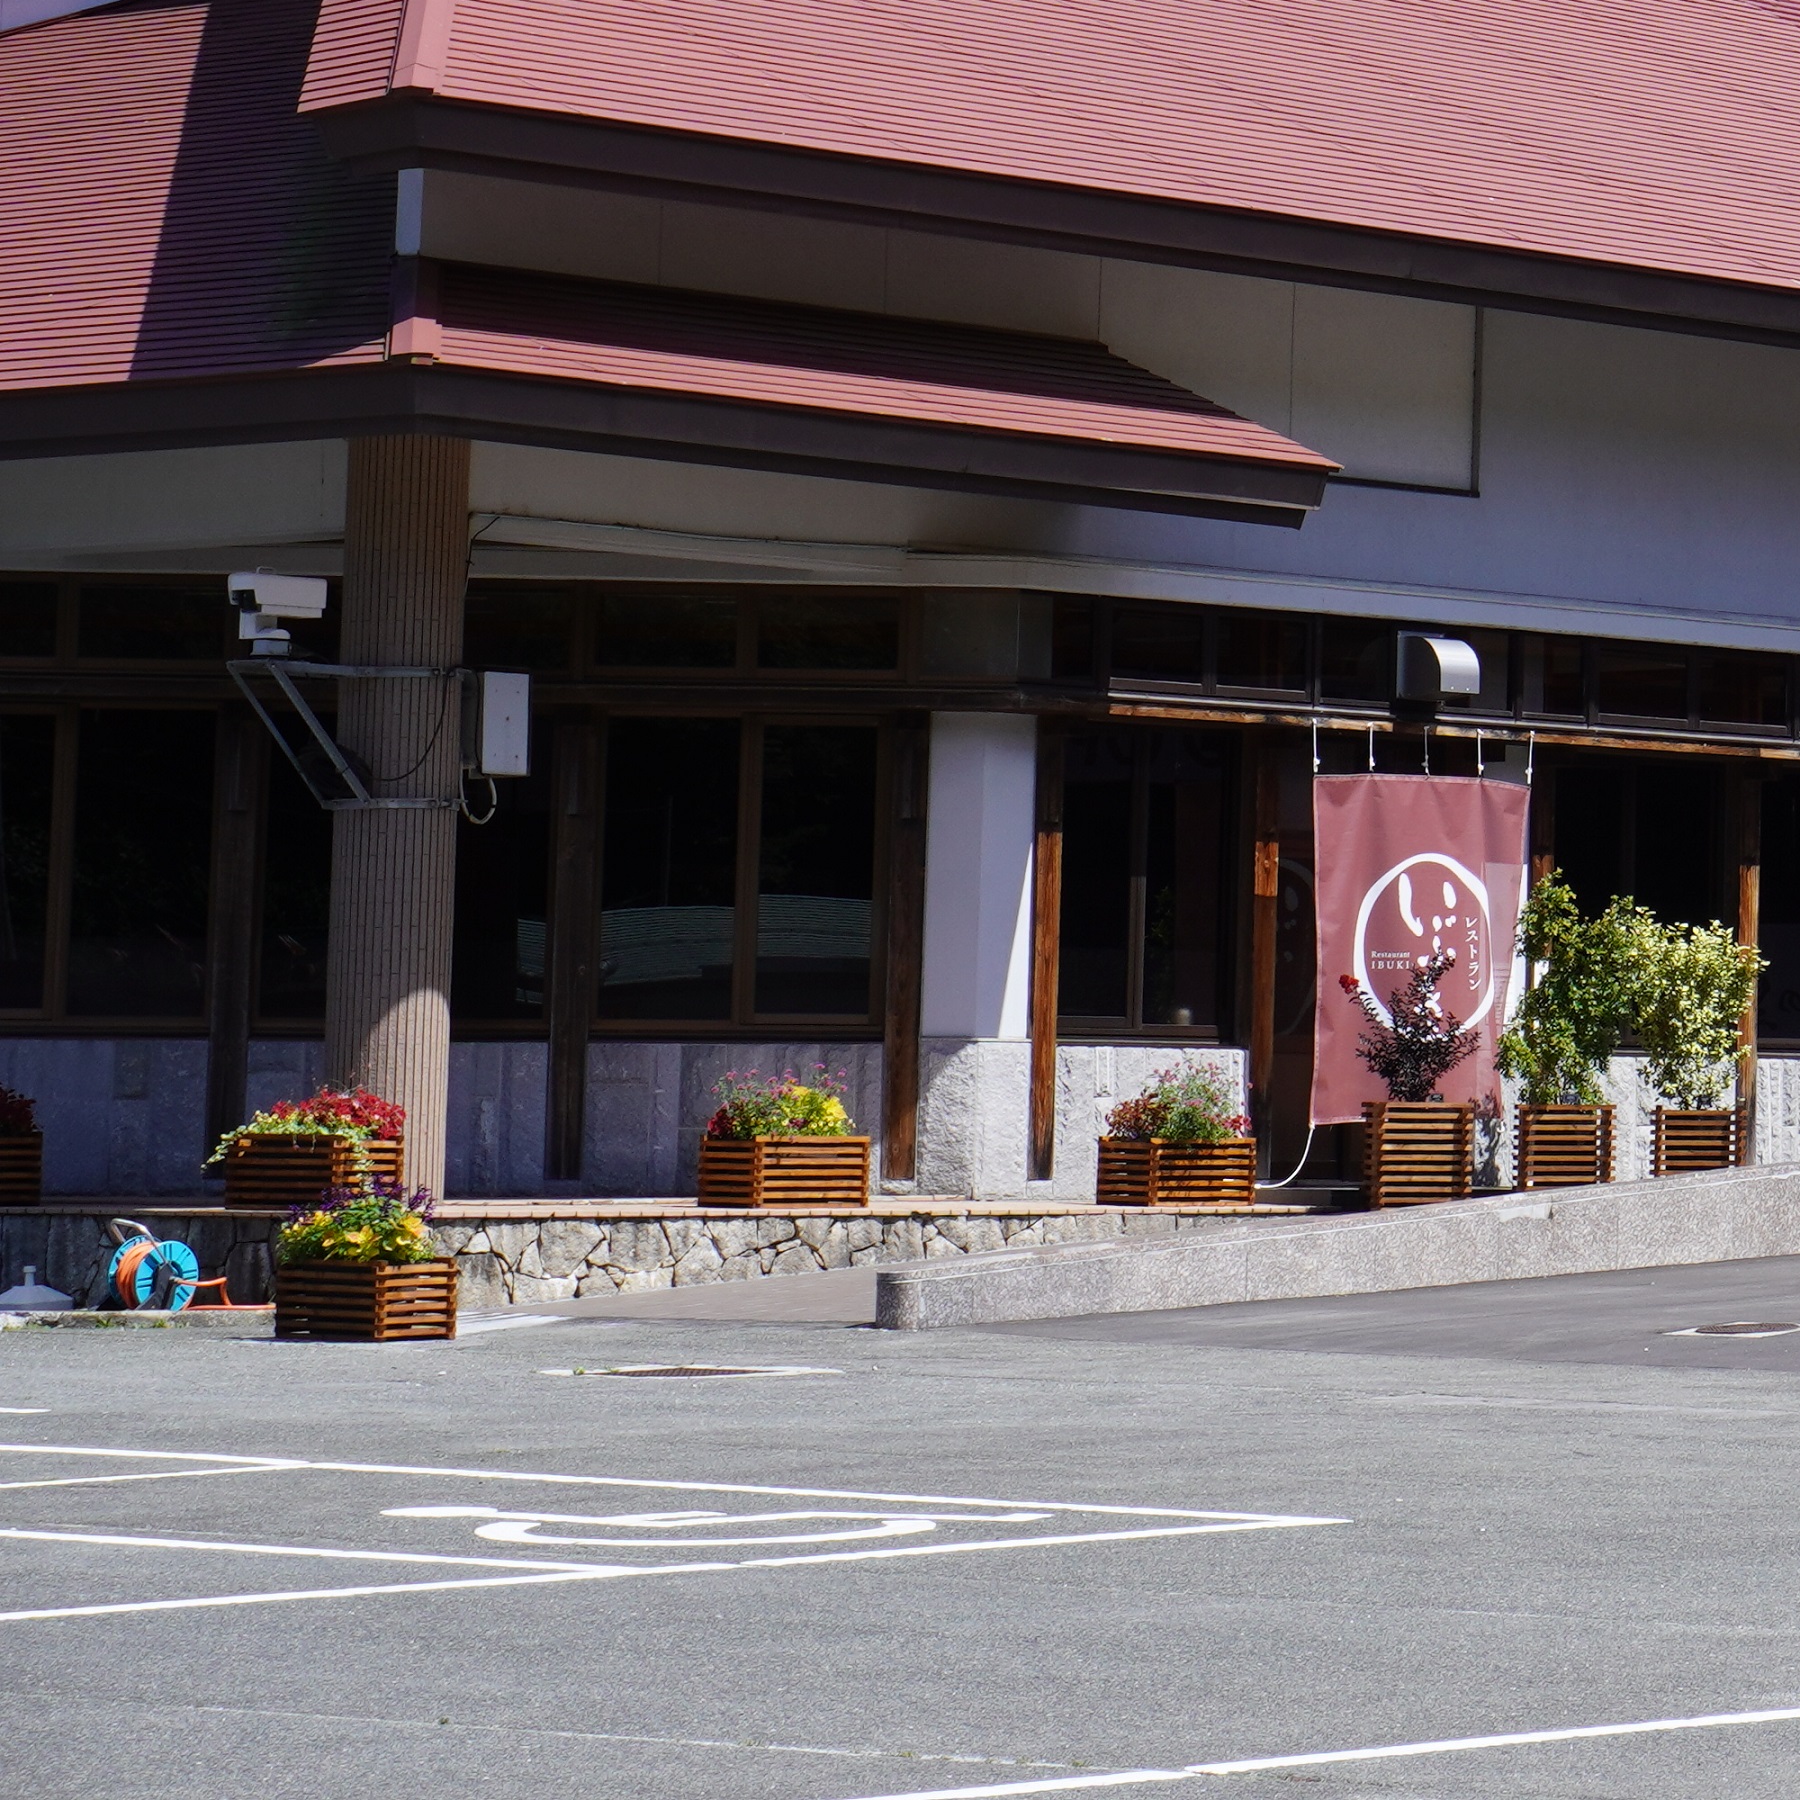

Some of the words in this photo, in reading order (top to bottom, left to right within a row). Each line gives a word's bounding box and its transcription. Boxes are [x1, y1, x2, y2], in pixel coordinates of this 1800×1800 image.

[1371, 950, 1411, 958] Restaurant
[1464, 916, 1482, 991] レストラン
[1371, 960, 1411, 970] IBUKI
